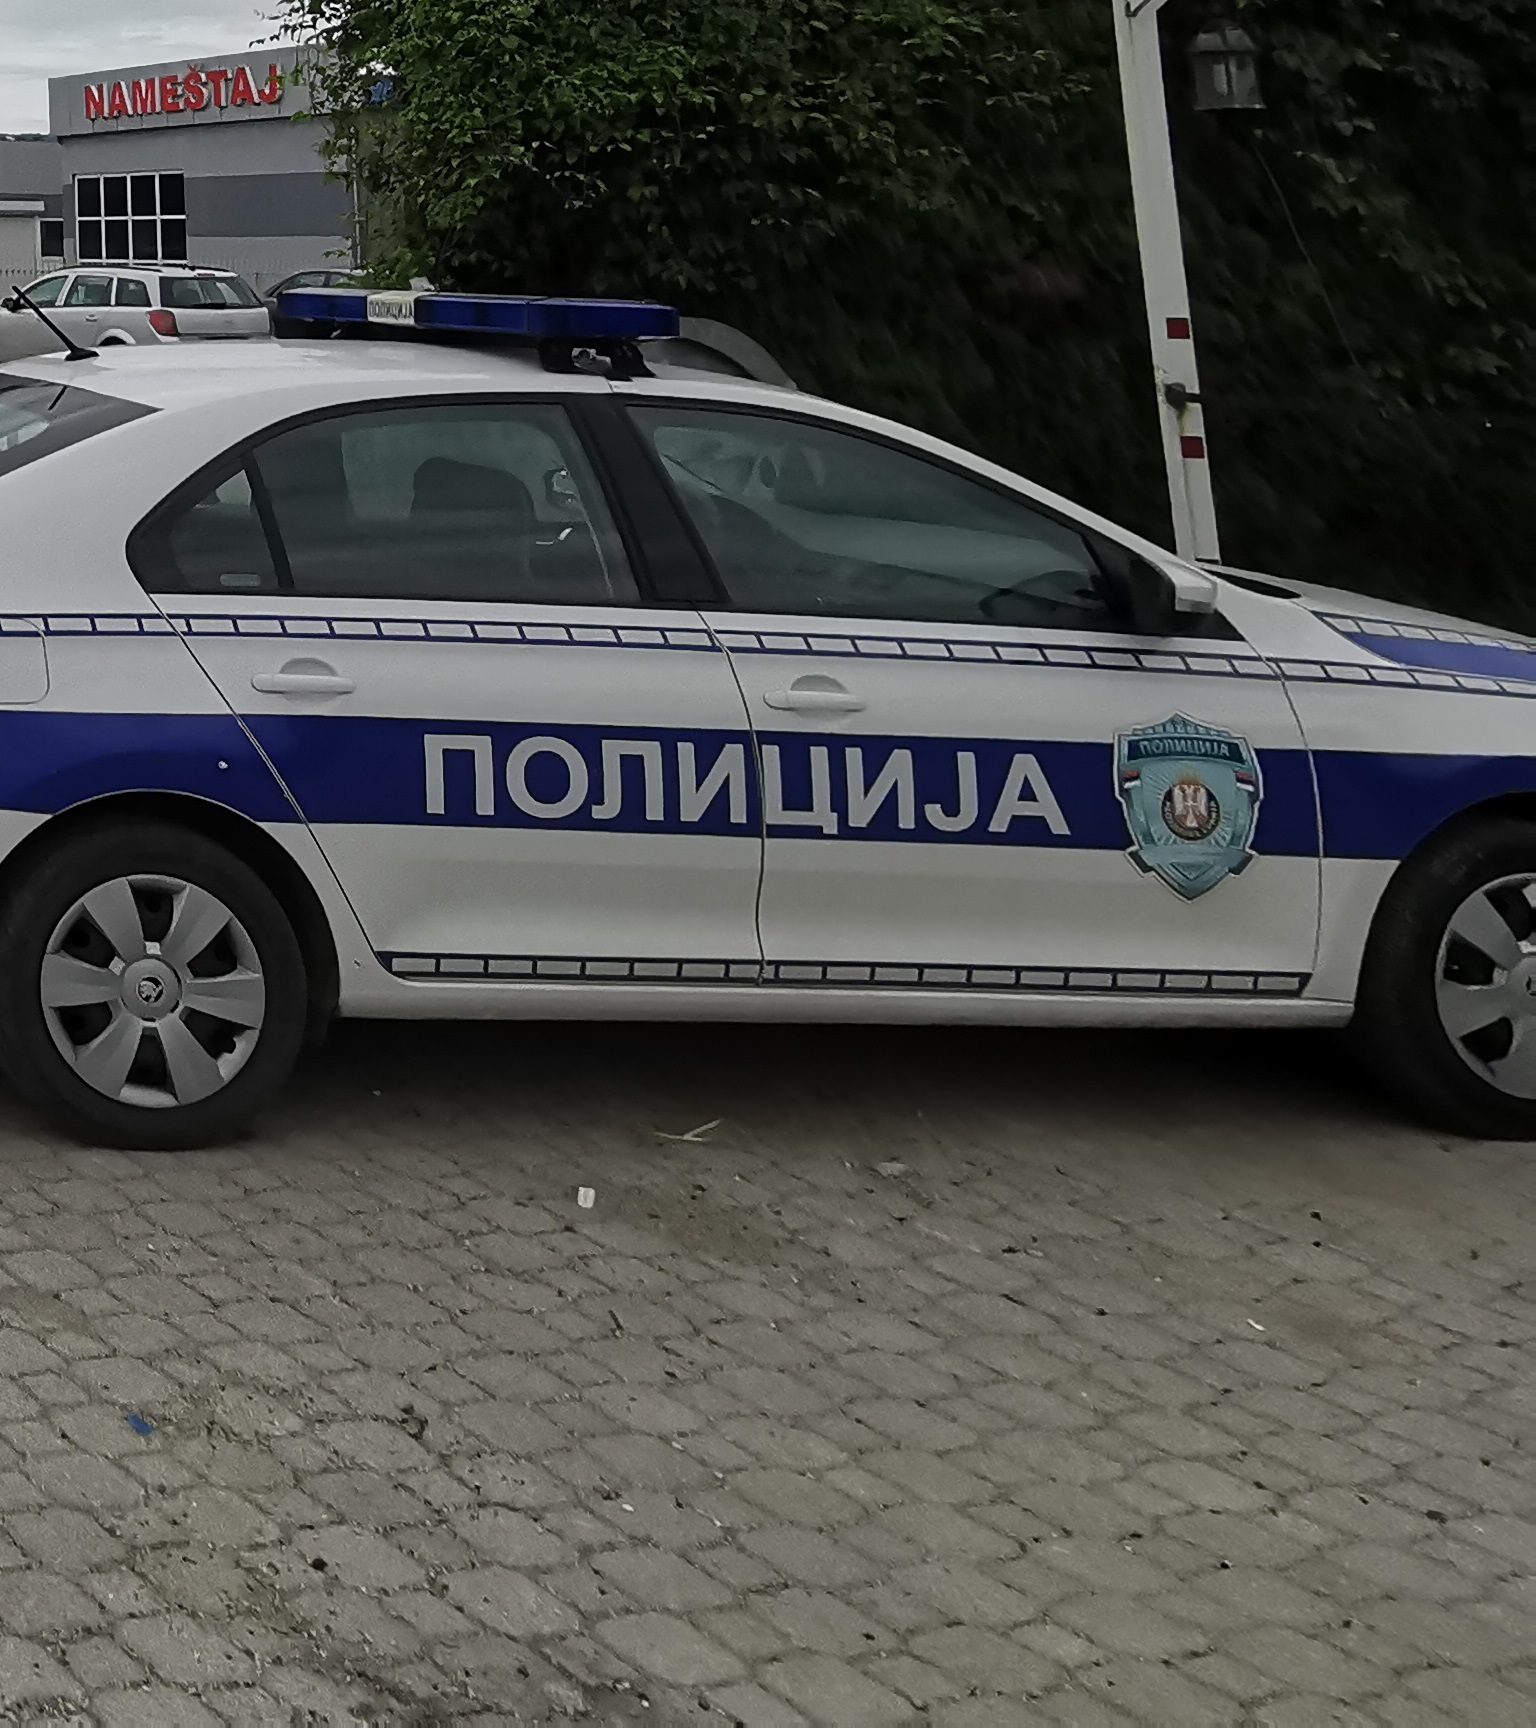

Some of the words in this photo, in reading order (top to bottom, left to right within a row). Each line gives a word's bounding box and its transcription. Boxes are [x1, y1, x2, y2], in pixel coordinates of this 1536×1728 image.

[83, 62, 283, 121] NAMEŠTAJ
[1138, 738, 1231, 757] ПОЛИЦИЈА
[423, 733, 1072, 835] ПОЛИЦИЈА
